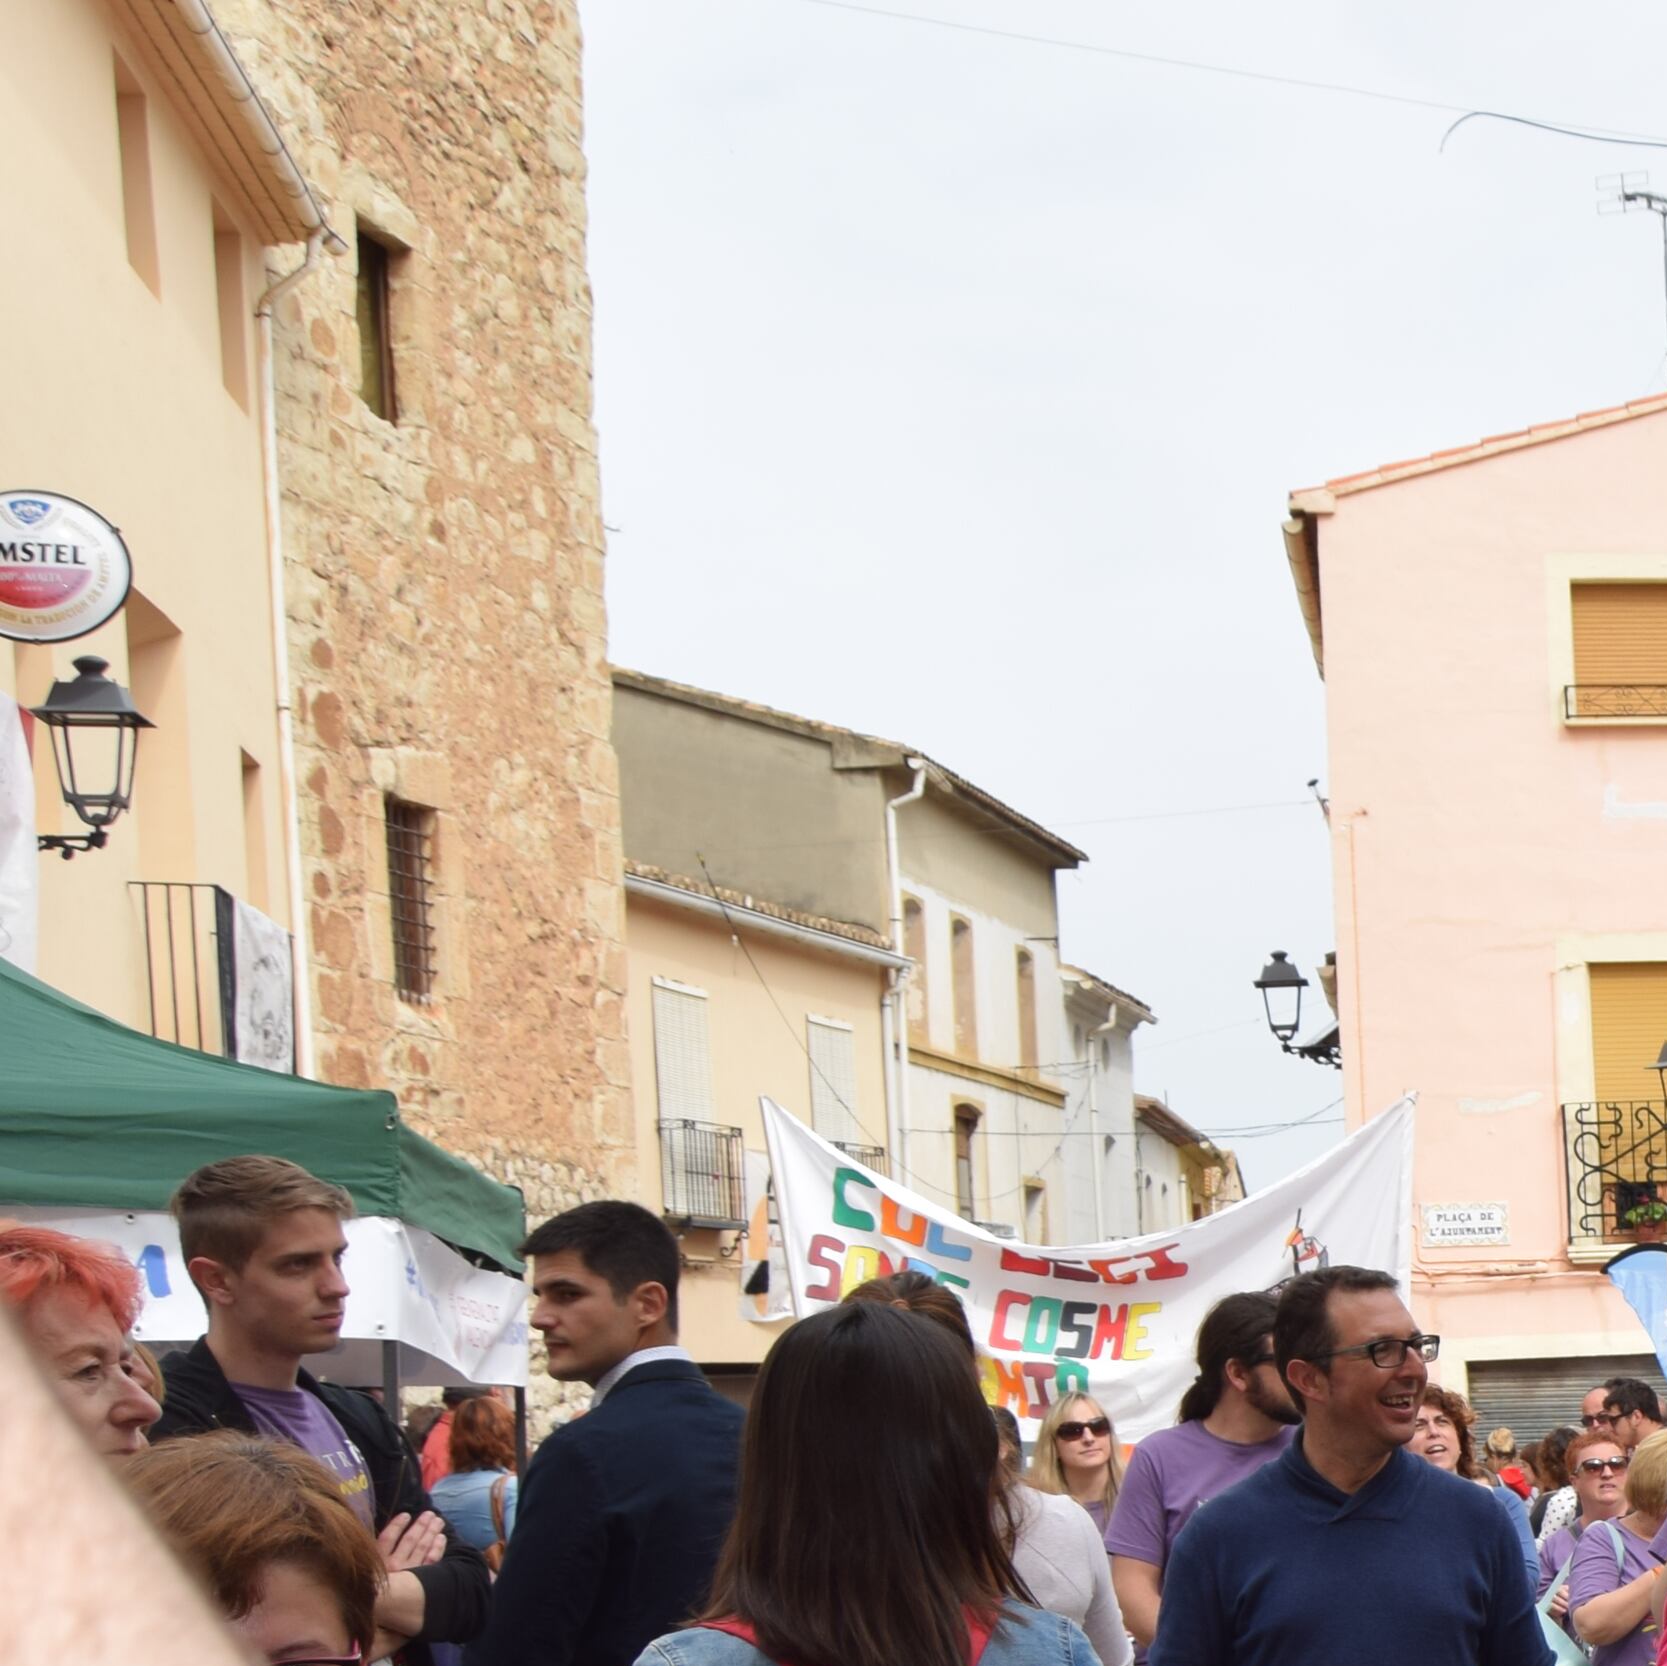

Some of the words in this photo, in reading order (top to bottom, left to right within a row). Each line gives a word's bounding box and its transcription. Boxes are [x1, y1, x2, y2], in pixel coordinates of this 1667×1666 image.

[0, 541, 86, 565] MSTEL
[1436, 1213, 1472, 1223] PLAÇA
[1480, 1213, 1494, 1221] DE
[989, 1289, 1162, 1361] COSME
